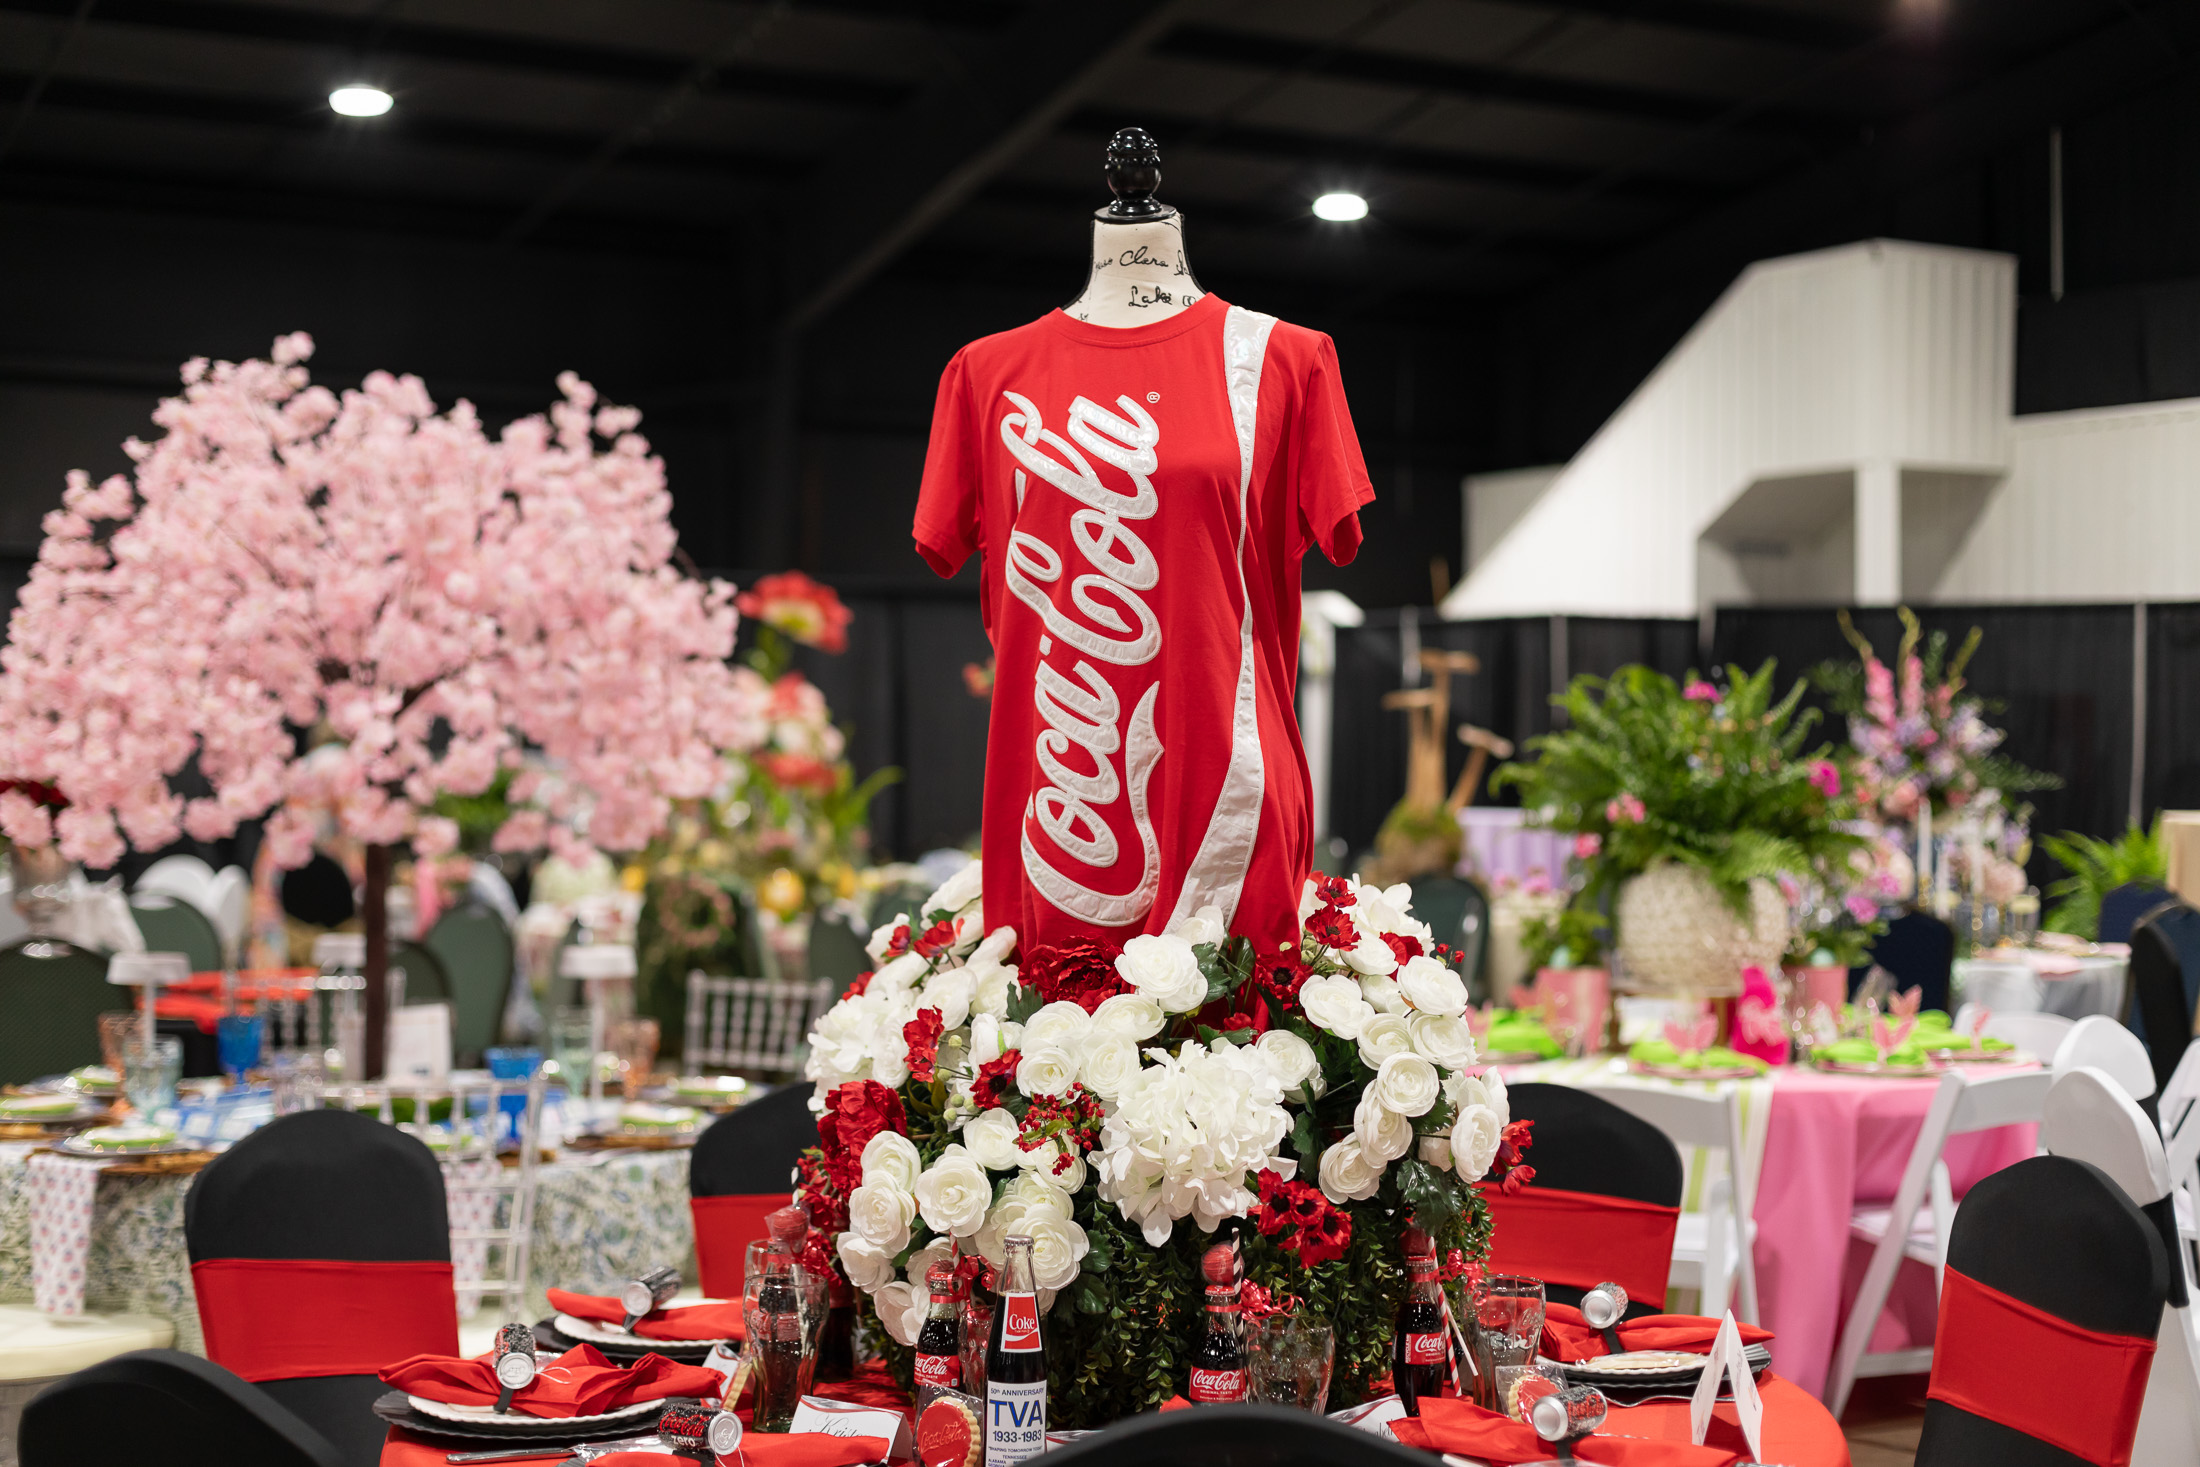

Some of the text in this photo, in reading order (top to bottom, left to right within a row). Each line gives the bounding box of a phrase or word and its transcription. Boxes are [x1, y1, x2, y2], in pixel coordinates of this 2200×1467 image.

[1119, 245, 1169, 267] Clara
[1001, 389, 1165, 927] Coca-Cola
[1009, 1313, 1035, 1330] Coke
[1193, 1369, 1241, 1390] Coca-Cola
[1001, 1386, 1044, 1396] ANNIVERSARY
[659, 1411, 710, 1437] Coca-Cola
[989, 1399, 1043, 1428] TVA
[671, 1435, 696, 1447] zero
[920, 1420, 963, 1454] Coca-Cola
[993, 1429, 1042, 1443] 1933-1983
